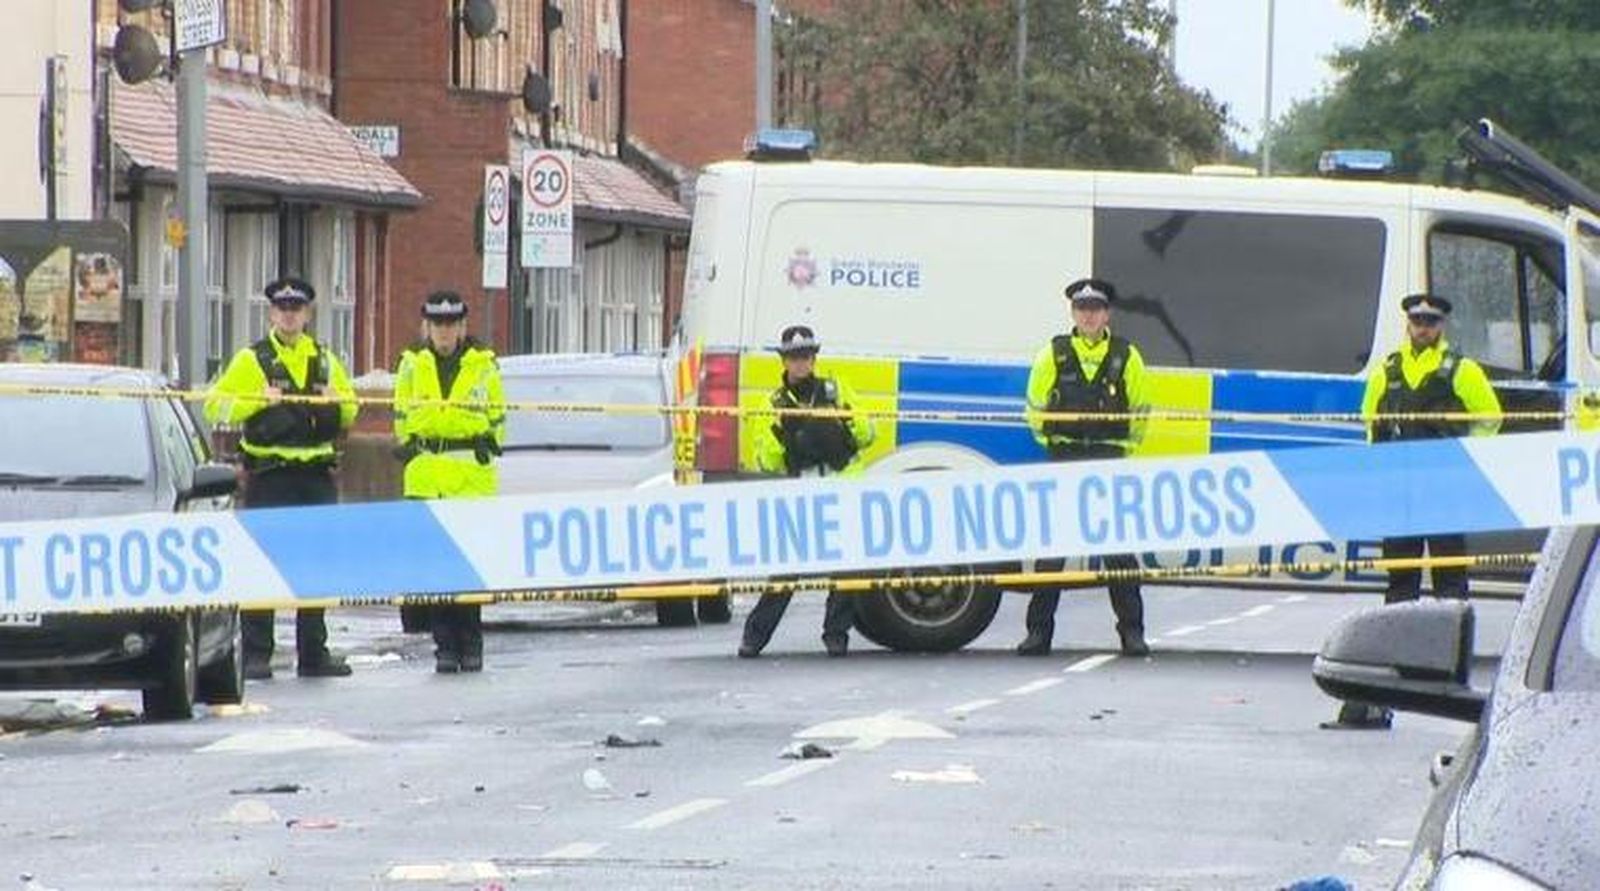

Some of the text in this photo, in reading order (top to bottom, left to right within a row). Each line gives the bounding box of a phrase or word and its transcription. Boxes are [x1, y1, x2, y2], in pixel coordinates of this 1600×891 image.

[534, 170, 562, 192] 20
[526, 212, 568, 228] ZONE
[830, 269, 921, 288] POLICE
[1557, 446, 1600, 516] P
[522, 466, 1256, 577] POLICE LINE DO NOT CROSS
[45, 526, 223, 600] CROSS
